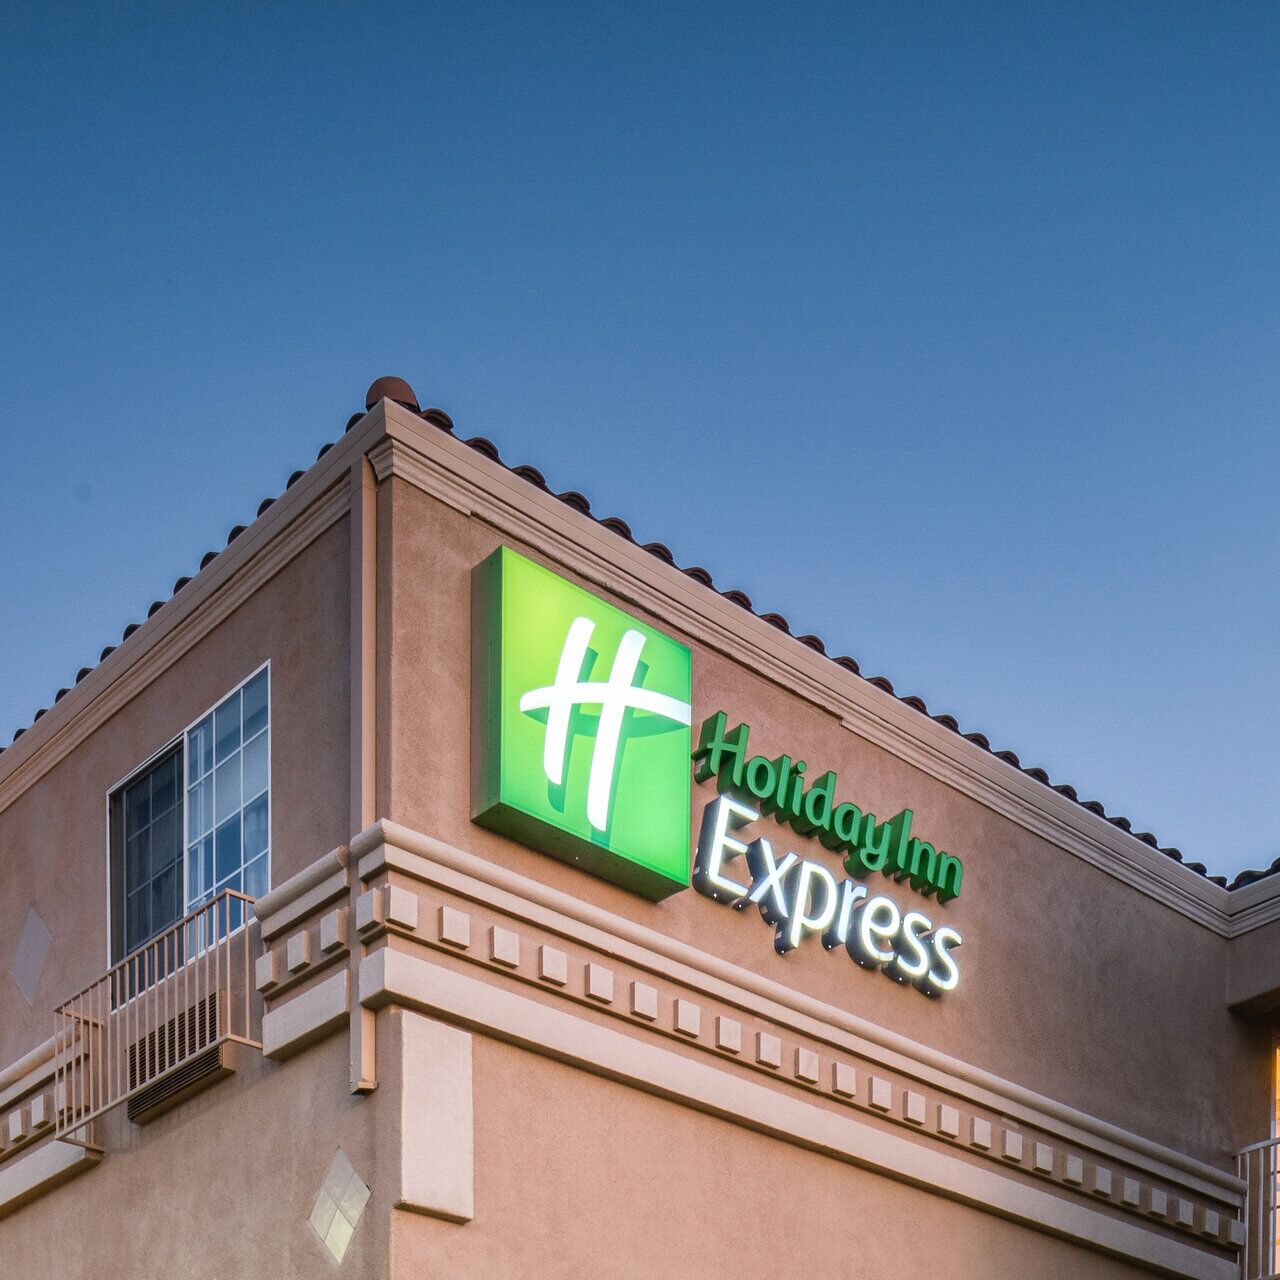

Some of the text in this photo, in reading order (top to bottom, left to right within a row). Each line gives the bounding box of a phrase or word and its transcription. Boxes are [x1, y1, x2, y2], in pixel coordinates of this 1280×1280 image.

[695, 711, 963, 902] Holiday Inn
[697, 794, 963, 995] Express
